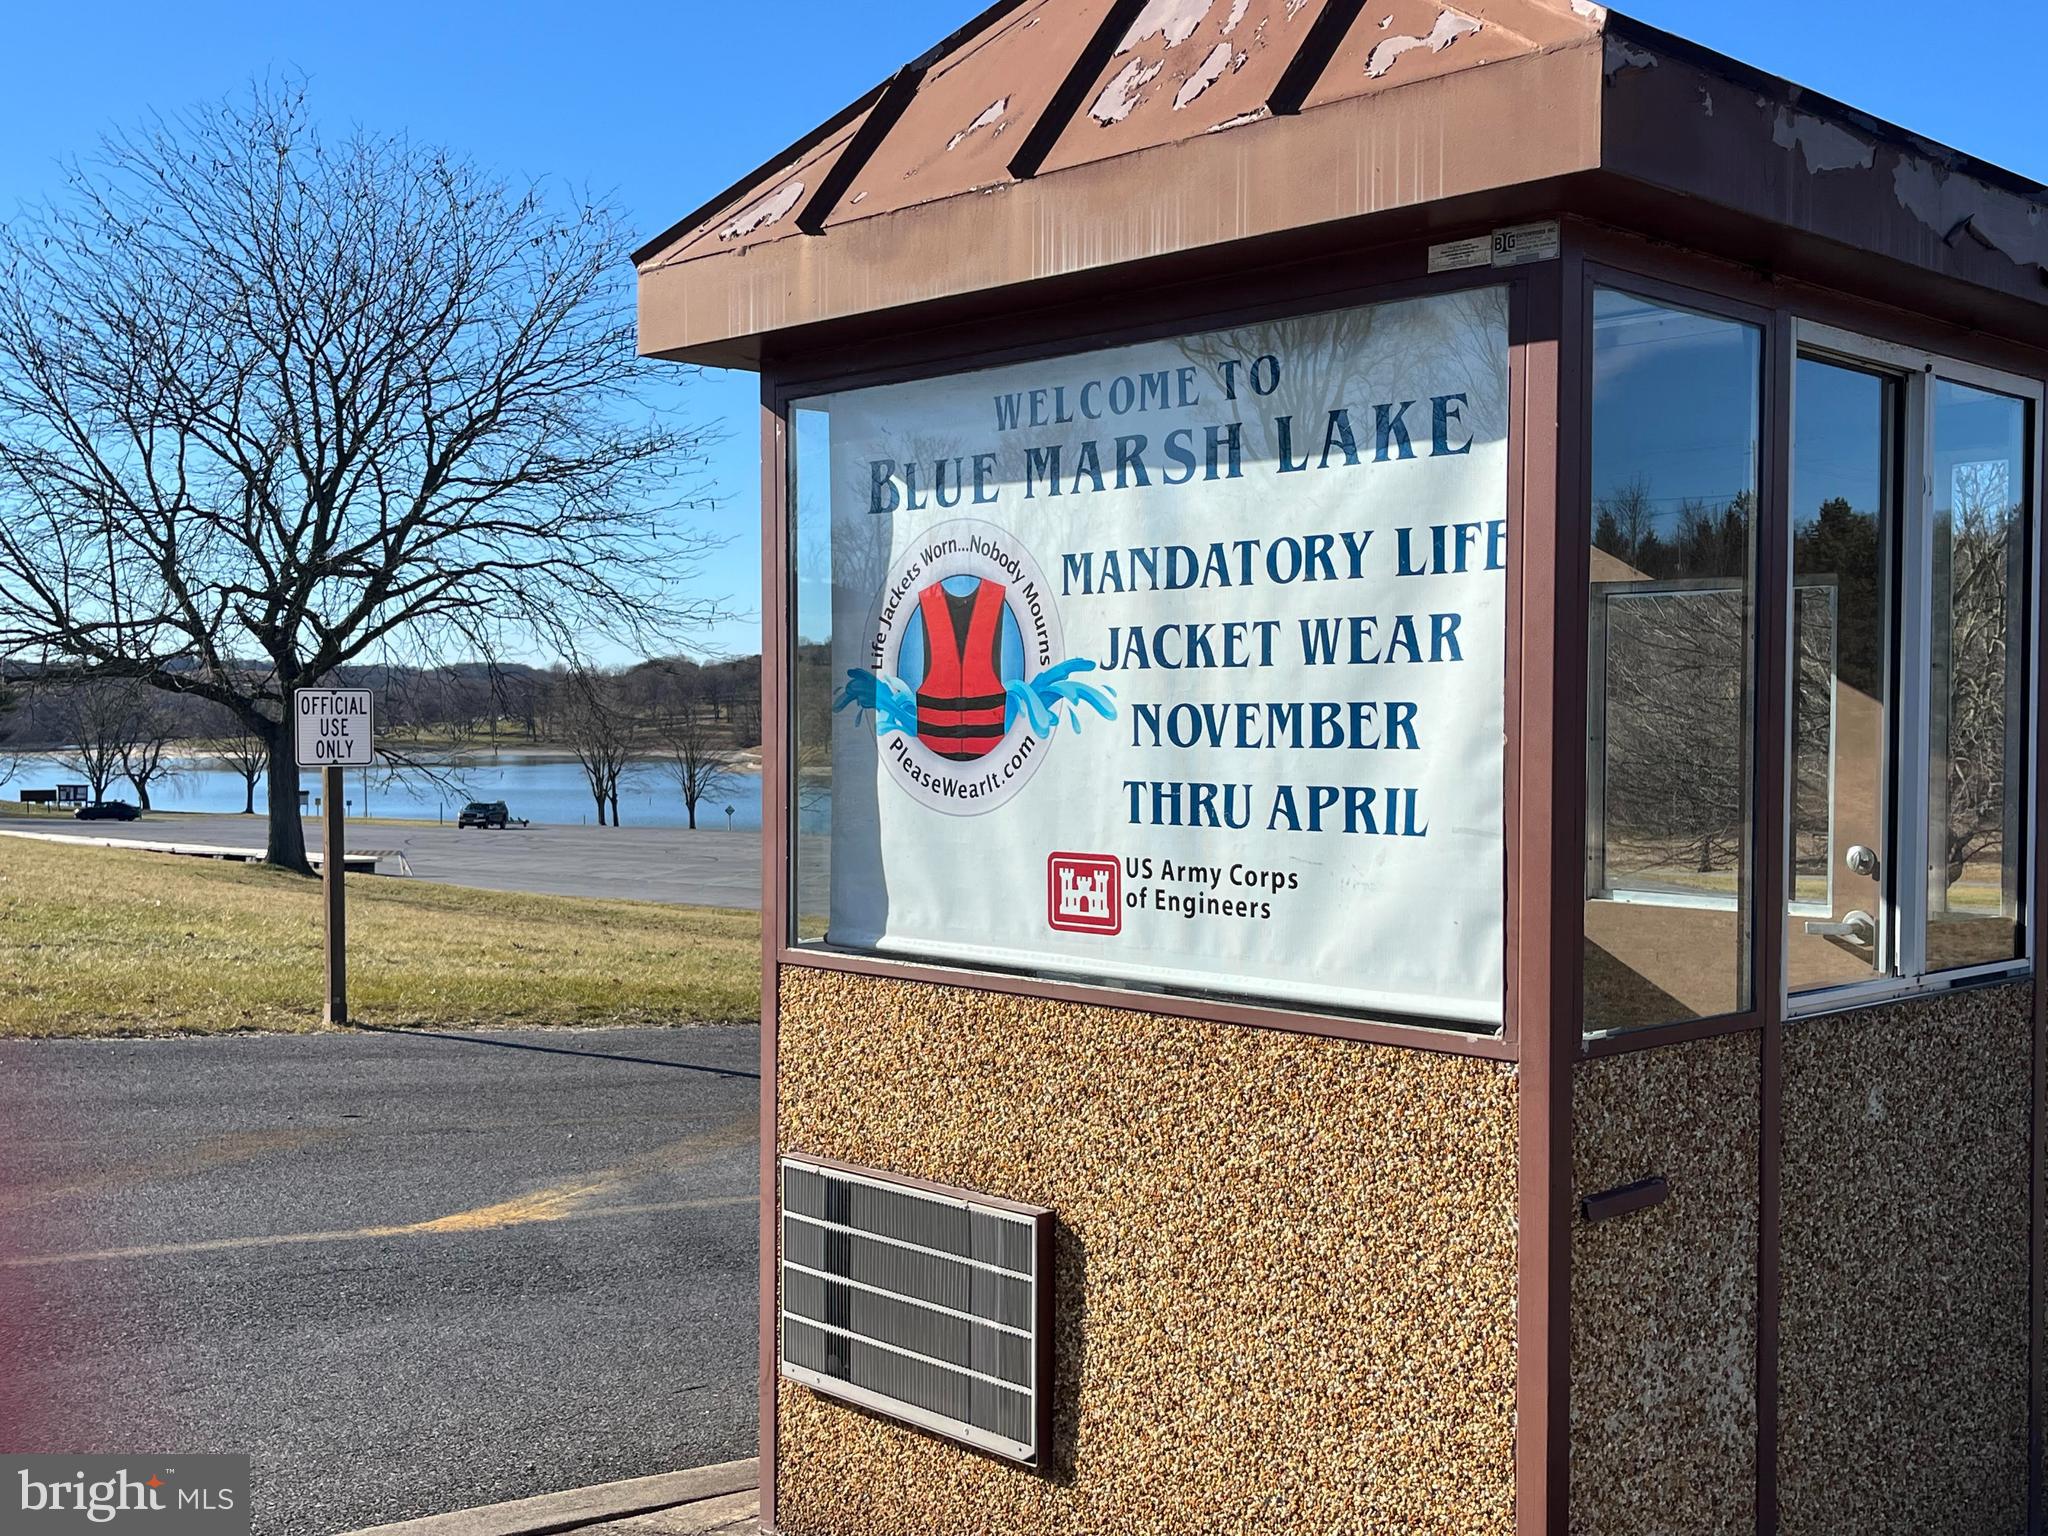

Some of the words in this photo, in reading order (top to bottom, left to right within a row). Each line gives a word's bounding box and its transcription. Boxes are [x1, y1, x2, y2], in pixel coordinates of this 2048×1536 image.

[993, 366, 1200, 432] WELCOME
[1217, 354, 1281, 401] TO
[867, 452, 1000, 515] BLUE
[1022, 422, 1245, 499] MARSH
[1274, 392, 1475, 474] LAKE
[1061, 530, 1375, 597] MANDATORY
[1394, 519, 1506, 577] LIFE
[878, 562, 921, 630] Jackets
[1022, 581, 1051, 666] Mourns
[871, 632, 887, 670] Life
[1100, 620, 1280, 672] JACKET
[1298, 613, 1464, 667] WEAR
[301, 696, 368, 716] OFFICIAL
[320, 718, 349, 737] USE
[1131, 701, 1421, 750] NOVEMBER
[316, 740, 354, 759] ONLY
[889, 735, 1036, 799] PleaseWearIt.com
[1123, 780, 1253, 830] THRU
[1266, 785, 1430, 838] APRIL
[1126, 856, 1153, 880] US
[1161, 859, 1222, 890] Army
[1229, 863, 1299, 895] Corps
[1126, 886, 1148, 909] of
[1155, 889, 1272, 919] Engineers
